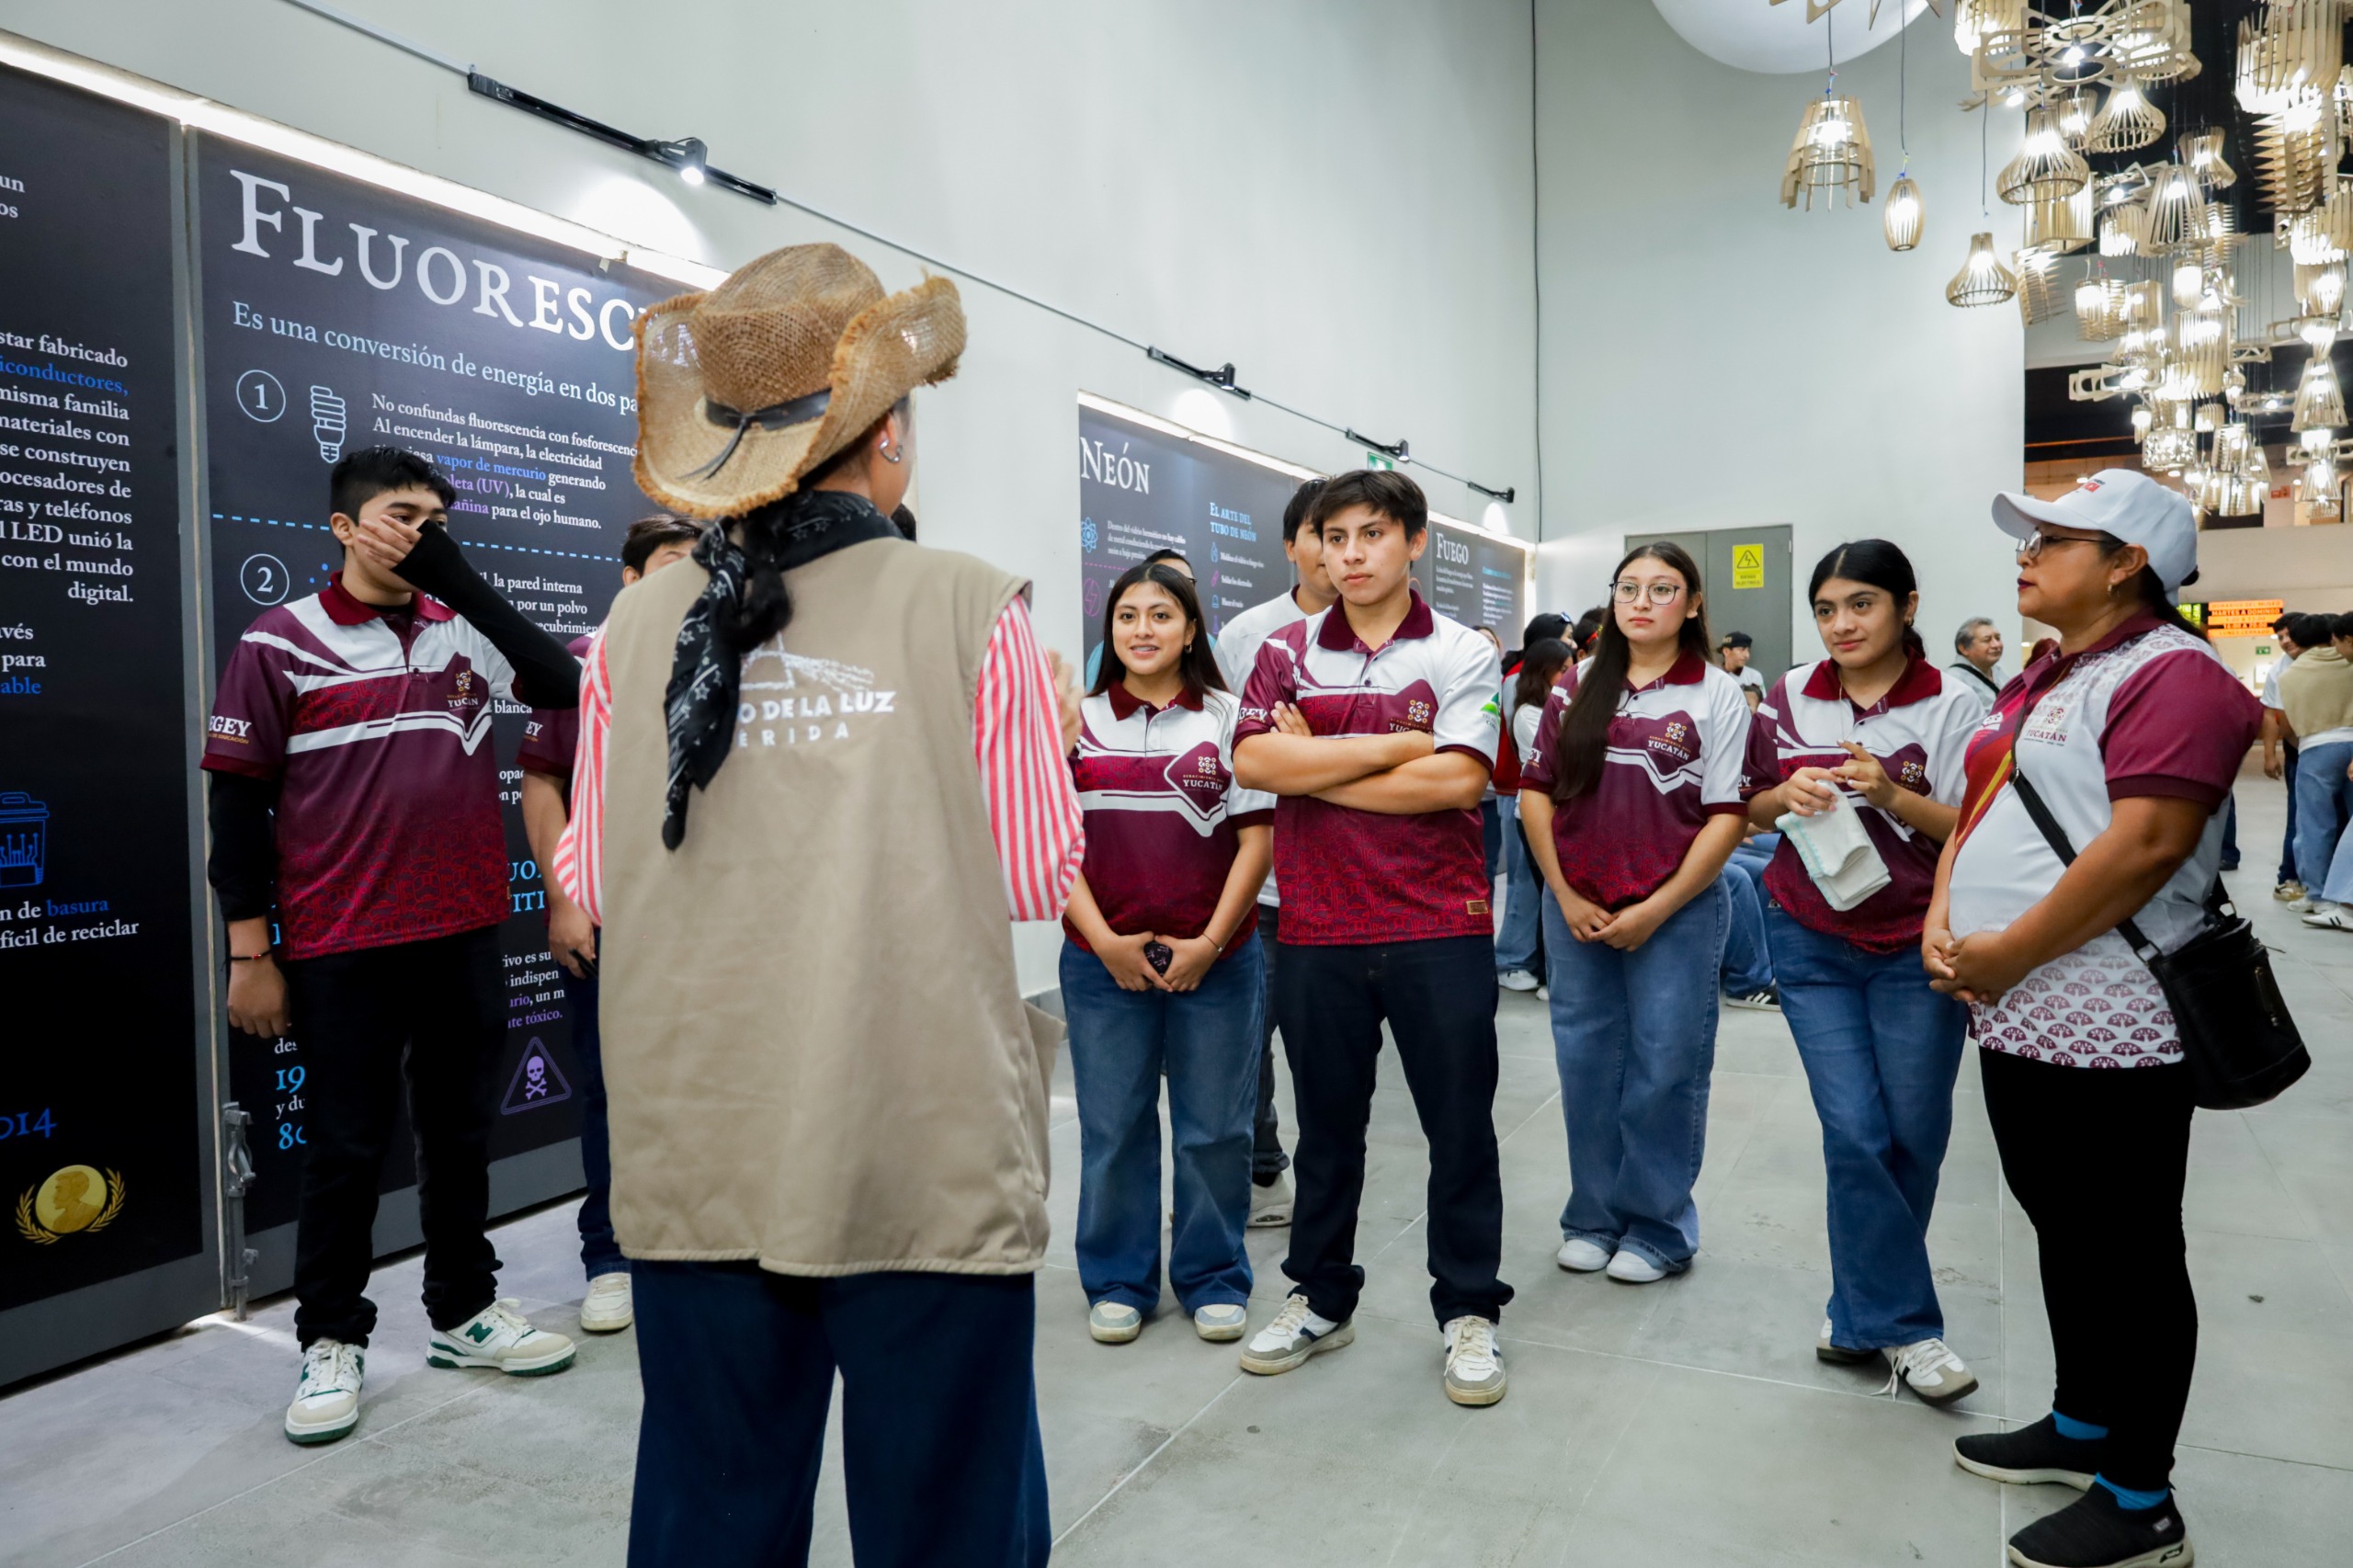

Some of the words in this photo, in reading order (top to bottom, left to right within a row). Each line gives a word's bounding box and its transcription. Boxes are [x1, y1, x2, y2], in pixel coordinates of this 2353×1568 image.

[230, 169, 647, 351] FLUORESC
[39, 335, 129, 368] fabricado
[233, 301, 264, 330] Es
[270, 317, 318, 343] una
[324, 329, 447, 372] conversión
[451, 353, 477, 378] de
[482, 365, 555, 396] energía
[559, 382, 582, 401] en
[585, 382, 616, 407] dos
[63, 392, 130, 421] familia
[254, 383, 268, 410] 1
[371, 392, 395, 412] No
[398, 403, 466, 426] confundas
[468, 412, 547, 440] fluorescencia
[549, 432, 570, 445] con
[96, 431, 130, 447] con
[372, 416, 391, 434] Al
[393, 427, 454, 445] encender
[457, 431, 469, 448] la
[471, 434, 524, 460] lámpara,
[526, 444, 537, 460] la
[539, 447, 603, 471] electricidad
[25, 446, 131, 474] construyen
[437, 454, 472, 472] vapor
[475, 457, 490, 472] de
[494, 463, 547, 481] mercurio
[549, 472, 607, 491] generando
[1080, 437, 1150, 495] NEÓN
[109, 480, 132, 498] de
[476, 478, 514, 499] (UV),
[515, 483, 526, 498] la
[529, 489, 552, 503] cual
[554, 494, 566, 505] es
[28, 502, 41, 520] y
[45, 500, 133, 525] teléfonos
[450, 499, 490, 515] añina
[492, 506, 518, 520] para
[520, 506, 531, 519] el
[533, 508, 551, 526] ojo
[553, 509, 602, 529] humano.
[11, 521, 63, 544] LED
[68, 531, 113, 549] unió
[117, 532, 134, 551] la
[1436, 532, 1469, 565] FUEGO
[1, 554, 40, 570] con
[43, 552, 62, 571] el
[66, 558, 134, 576] mundo
[256, 566, 274, 593] 2
[494, 573, 505, 587] la
[507, 576, 540, 593] pared
[542, 578, 583, 594] interna
[67, 581, 134, 606] digital.
[517, 600, 538, 612] por
[540, 601, 555, 612] un
[557, 600, 588, 618] polvo
[2, 654, 47, 673] para
[494, 699, 533, 714] blanca
[762, 700, 795, 722] DE
[800, 695, 833, 717] LA
[840, 691, 897, 713] LUZ
[1648, 739, 1689, 761] YUCATÁN
[17, 901, 42, 919] de
[46, 899, 110, 917] basura
[43, 926, 67, 944] de
[72, 919, 140, 941] reciclar
[525, 953, 537, 964] es
[535, 991, 551, 1003] un
[525, 1009, 563, 1025] tóxico.
[276, 1103, 286, 1120] y
